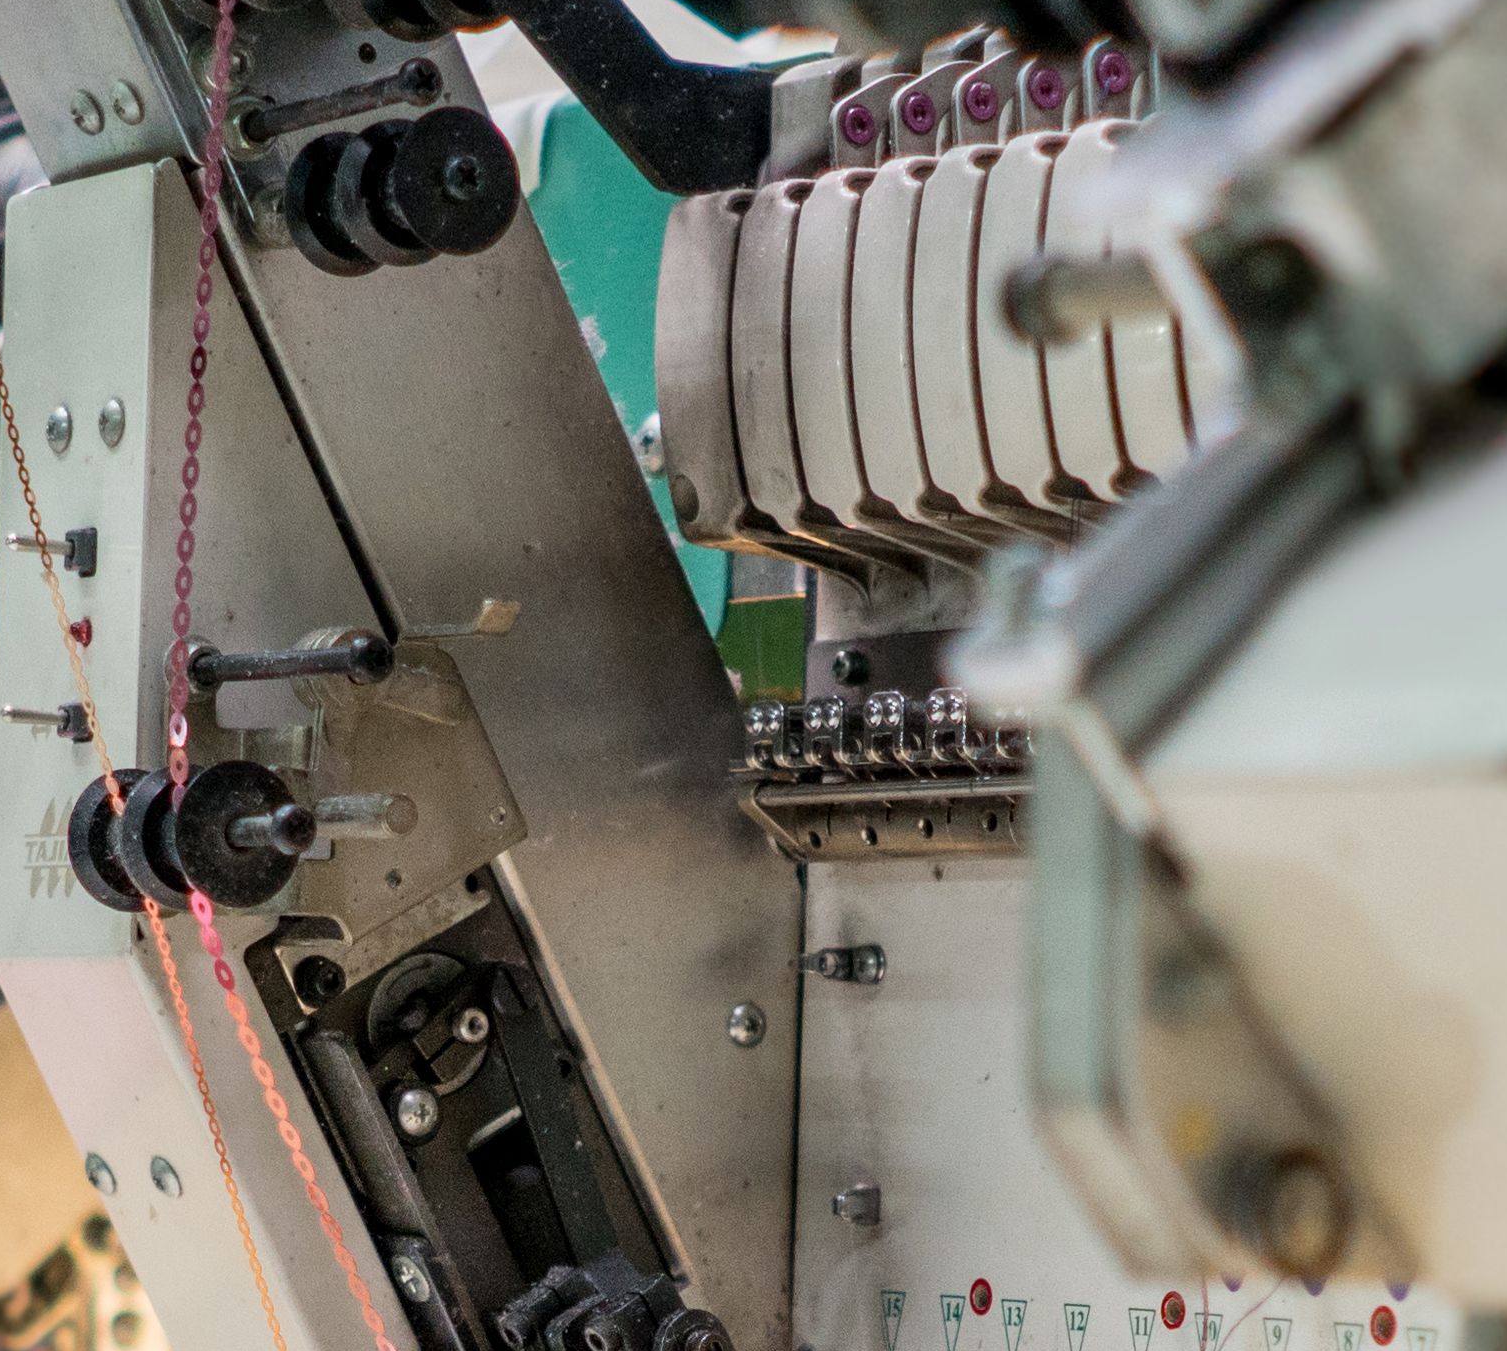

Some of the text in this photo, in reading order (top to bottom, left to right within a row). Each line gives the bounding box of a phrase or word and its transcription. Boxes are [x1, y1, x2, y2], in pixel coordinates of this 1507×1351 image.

[885, 1297, 902, 1318] 15
[945, 1301, 961, 1322] 14
[1006, 1305, 1022, 1327] 13
[1069, 1310, 1085, 1332] 12
[1134, 1315, 1149, 1337] 11
[1272, 1325, 1282, 1346] 9
